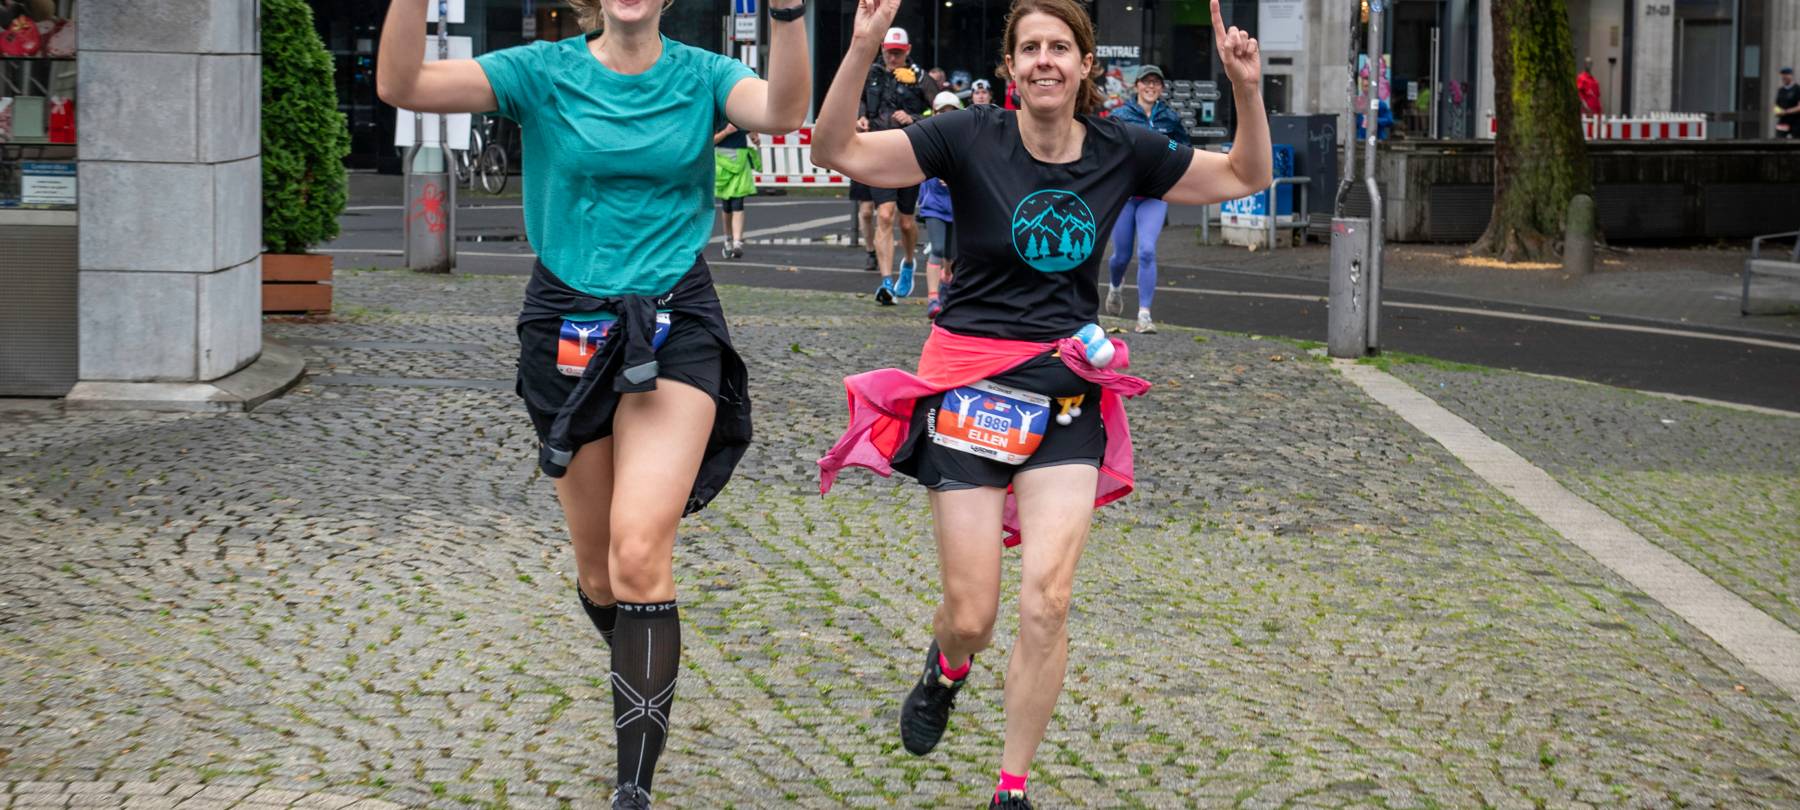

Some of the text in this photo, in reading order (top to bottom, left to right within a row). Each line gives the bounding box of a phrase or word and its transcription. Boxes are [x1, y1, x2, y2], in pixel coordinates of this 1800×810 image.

[1096, 46, 1139, 57] ZENTRALE
[977, 414, 1009, 433] 1989
[968, 430, 1008, 447] ELLEN
